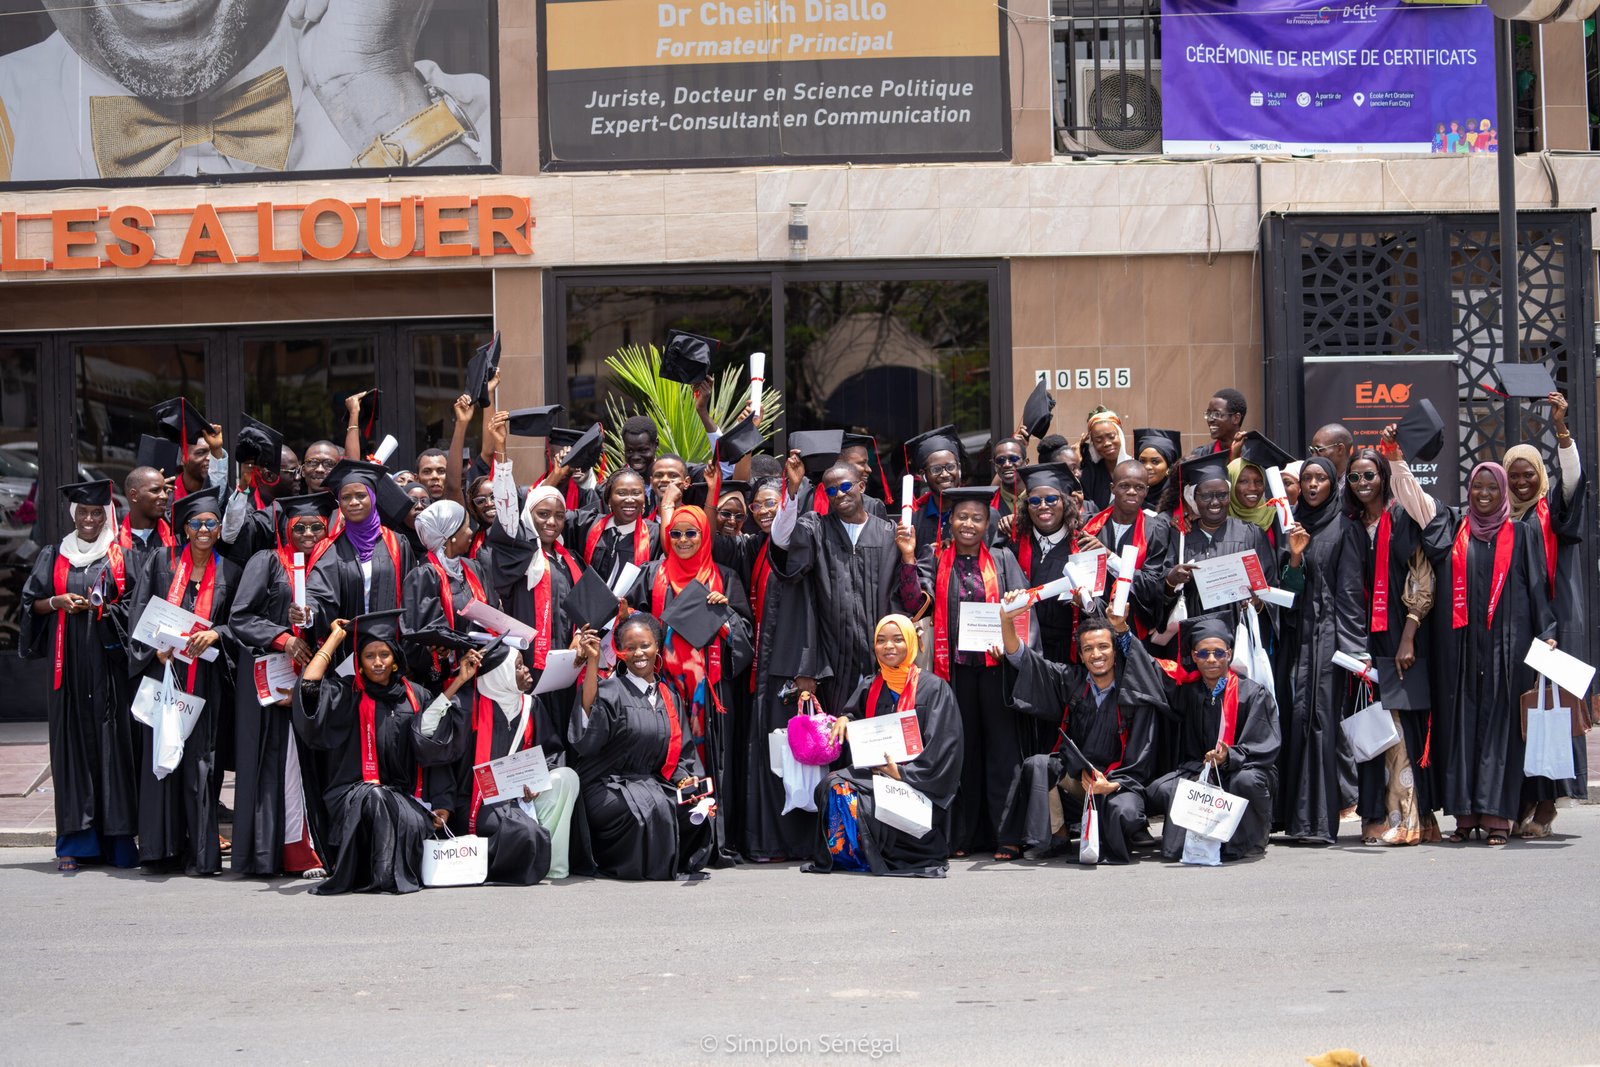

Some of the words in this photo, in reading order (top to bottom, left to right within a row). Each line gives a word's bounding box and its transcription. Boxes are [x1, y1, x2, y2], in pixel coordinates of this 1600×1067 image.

[658, 4, 692, 27] Dr
[700, 1, 796, 26] Cheikh
[805, 0, 887, 23] Diallo
[656, 36, 782, 58] Formateur
[788, 31, 894, 56] Principal
[1186, 43, 1273, 66] CÉRÉMONIE
[1277, 50, 1298, 67] DE
[1301, 49, 1357, 67] REMISE
[1361, 49, 1379, 66] DE
[1383, 48, 1477, 66] CERTIFICATS
[585, 89, 667, 110] Juriste,
[673, 86, 757, 105] Docteur
[763, 87, 786, 102] en
[793, 82, 873, 100] Science
[880, 79, 973, 101] Politique
[1320, 93, 1334, 101] partir
[1399, 100, 1411, 108] City)
[591, 110, 780, 137] Expert-Consultant
[783, 113, 807, 128] en
[814, 106, 971, 127] Communication
[1250, 143, 1282, 151] SIMPLON
[176, 203, 238, 266] A
[257, 194, 535, 263] LOUER
[1410, 464, 1438, 472] LEZ-Y
[885, 784, 925, 804] SIMPLN
[1187, 789, 1233, 811] SIMPLON
[432, 845, 478, 860] SIMPLON
